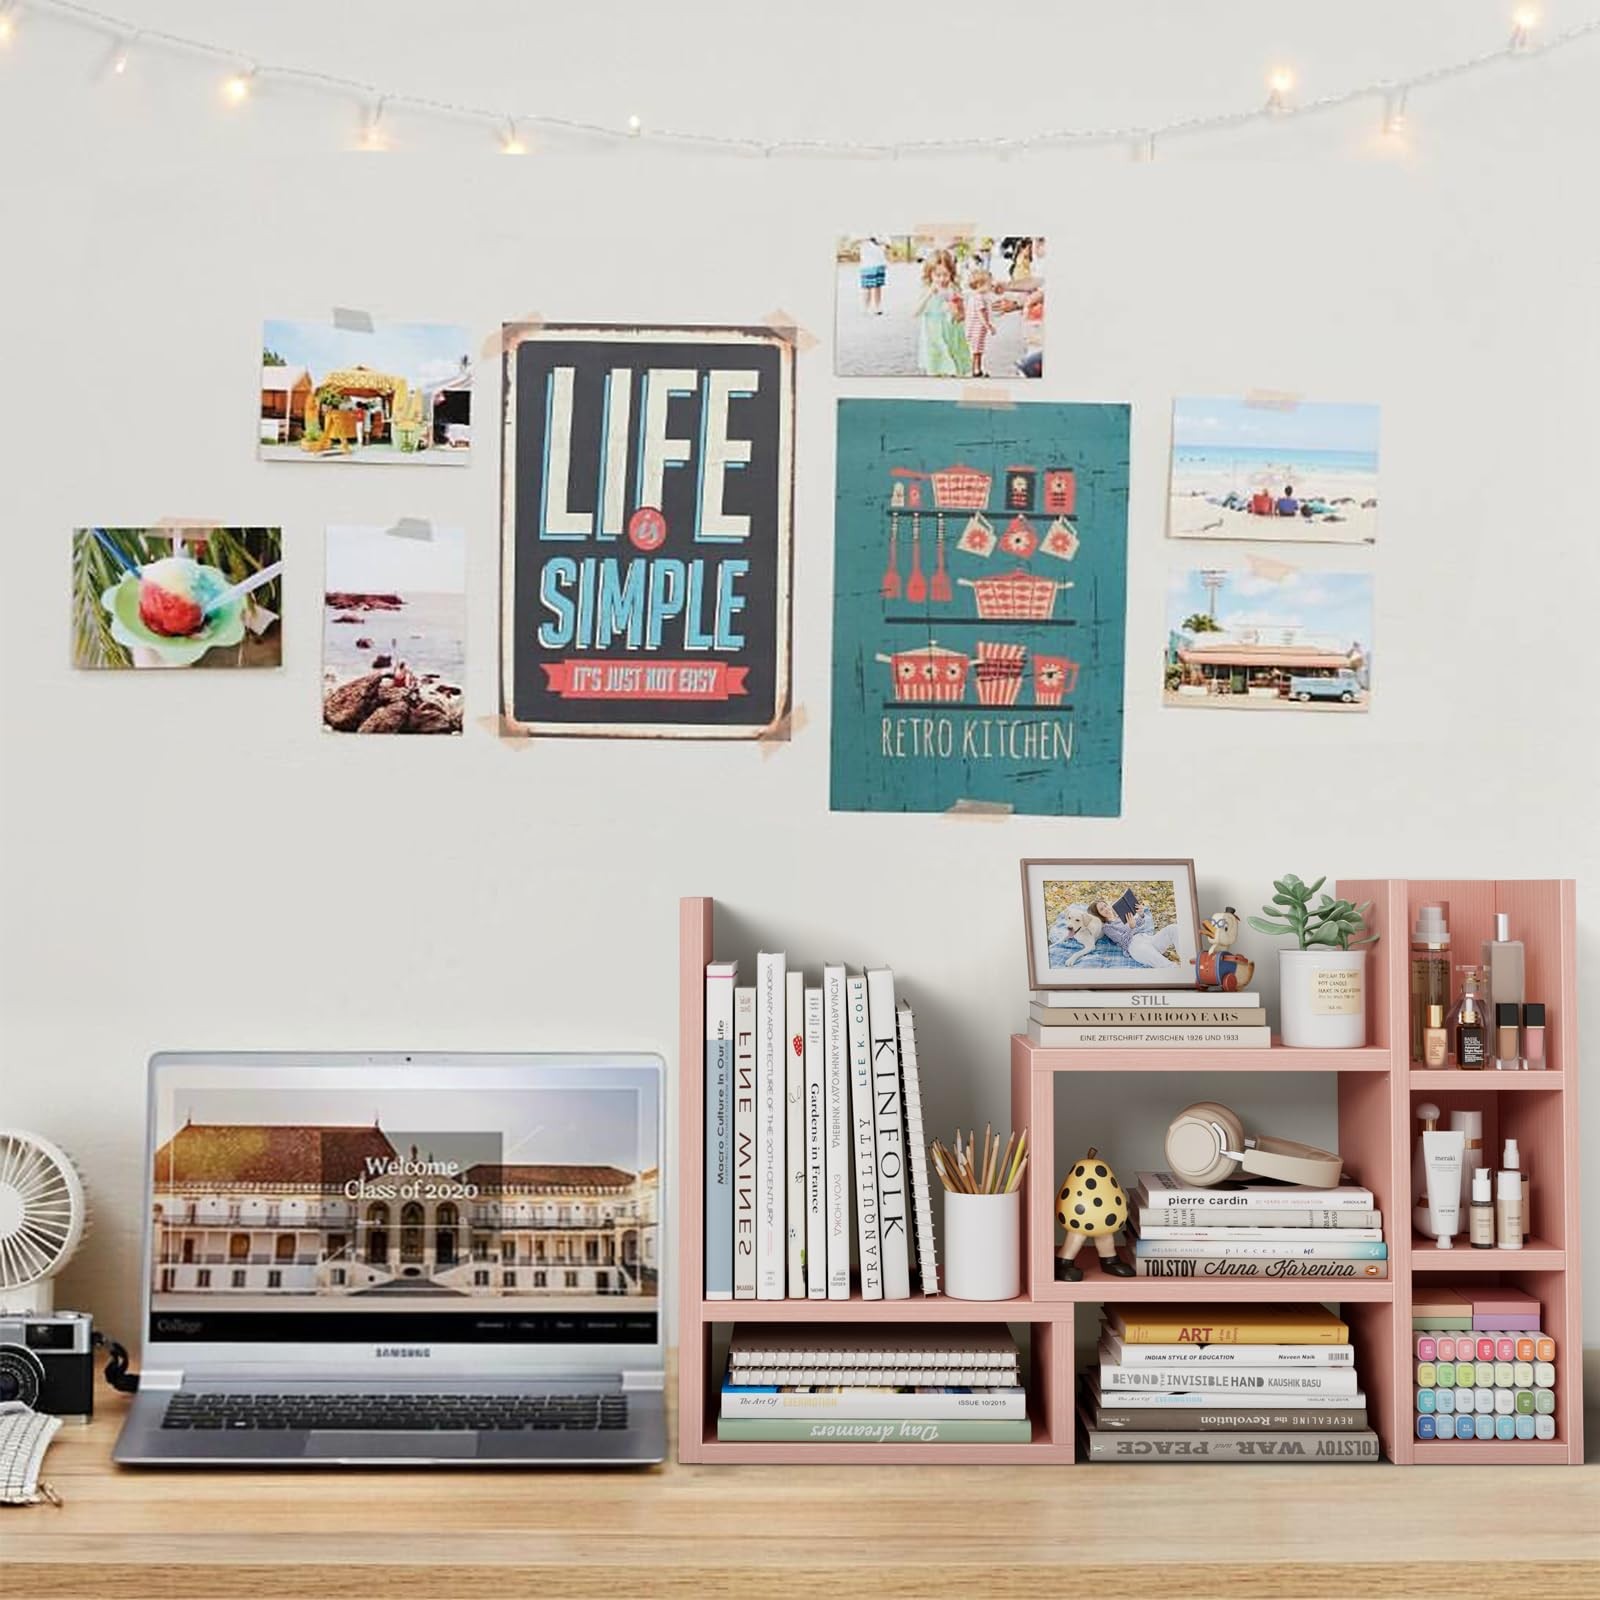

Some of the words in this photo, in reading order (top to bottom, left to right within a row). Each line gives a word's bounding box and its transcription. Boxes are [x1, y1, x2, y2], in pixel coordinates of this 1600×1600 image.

[539, 366, 759, 543] LIFE
[636, 511, 657, 542] is
[537, 557, 750, 652] SIMPLE
[571, 666, 602, 692] IT'S
[603, 667, 643, 692] JUST
[645, 667, 676, 693] NOT
[678, 667, 718, 693] EASY
[881, 716, 952, 758] RETRO
[963, 719, 1074, 760] KITCHEN
[854, 982, 864, 1024] COLE
[1131, 995, 1170, 1006] STILL
[1072, 1012, 1125, 1021] VANITY
[1186, 1012, 1239, 1021] YEARS
[717, 1020, 725, 1041] Life
[857, 1032, 865, 1048] K.
[717, 1045, 725, 1070] Our
[766, 1016, 774, 1096] ARCHITECTURE
[717, 1077, 725, 1086] In
[858, 1058, 867, 1087] LEE
[717, 1089, 725, 1137] Culture
[767, 1097, 774, 1113] OF
[810, 1083, 820, 1144] Gardens
[875, 1037, 904, 1239] KINFOLK
[717, 1140, 725, 1185] Macro
[811, 1146, 820, 1161] in
[365, 1156, 459, 1176] Welcome
[344, 1180, 397, 1200] Class
[400, 1180, 424, 1200] of
[425, 1184, 478, 1200] 2020
[811, 1164, 820, 1214] France
[858, 1118, 878, 1288] TRANQUILITY
[1168, 1196, 1205, 1206] pierre
[1208, 1195, 1248, 1206] cardin
[1144, 1259, 1197, 1277] TOLSTOY
[1204, 1259, 1259, 1276] Anna
[1265, 1259, 1357, 1278] Karenina
[1178, 1328, 1213, 1342] ART
[1112, 1373, 1159, 1385] BEYOND
[1167, 1375, 1229, 1387] INVISIBLE
[1230, 1376, 1265, 1388] HAND
[1268, 1377, 1300, 1388] KAUSHIK
[1301, 1379, 1322, 1388] BASU
[739, 1397, 752, 1405] The
[752, 1397, 766, 1405] Art
[767, 1397, 778, 1407] Of
[1200, 1416, 1270, 1425] Revolution
[1274, 1416, 1288, 1424] the
[1292, 1416, 1354, 1425] REVEALING
[810, 1421, 894, 1441] dreamers
[899, 1421, 939, 1440] Day
[1116, 1441, 1209, 1455] PEACE
[1212, 1441, 1233, 1450] and
[1235, 1441, 1306, 1455] WAR
[1315, 1439, 1380, 1456] TOLSTOY
